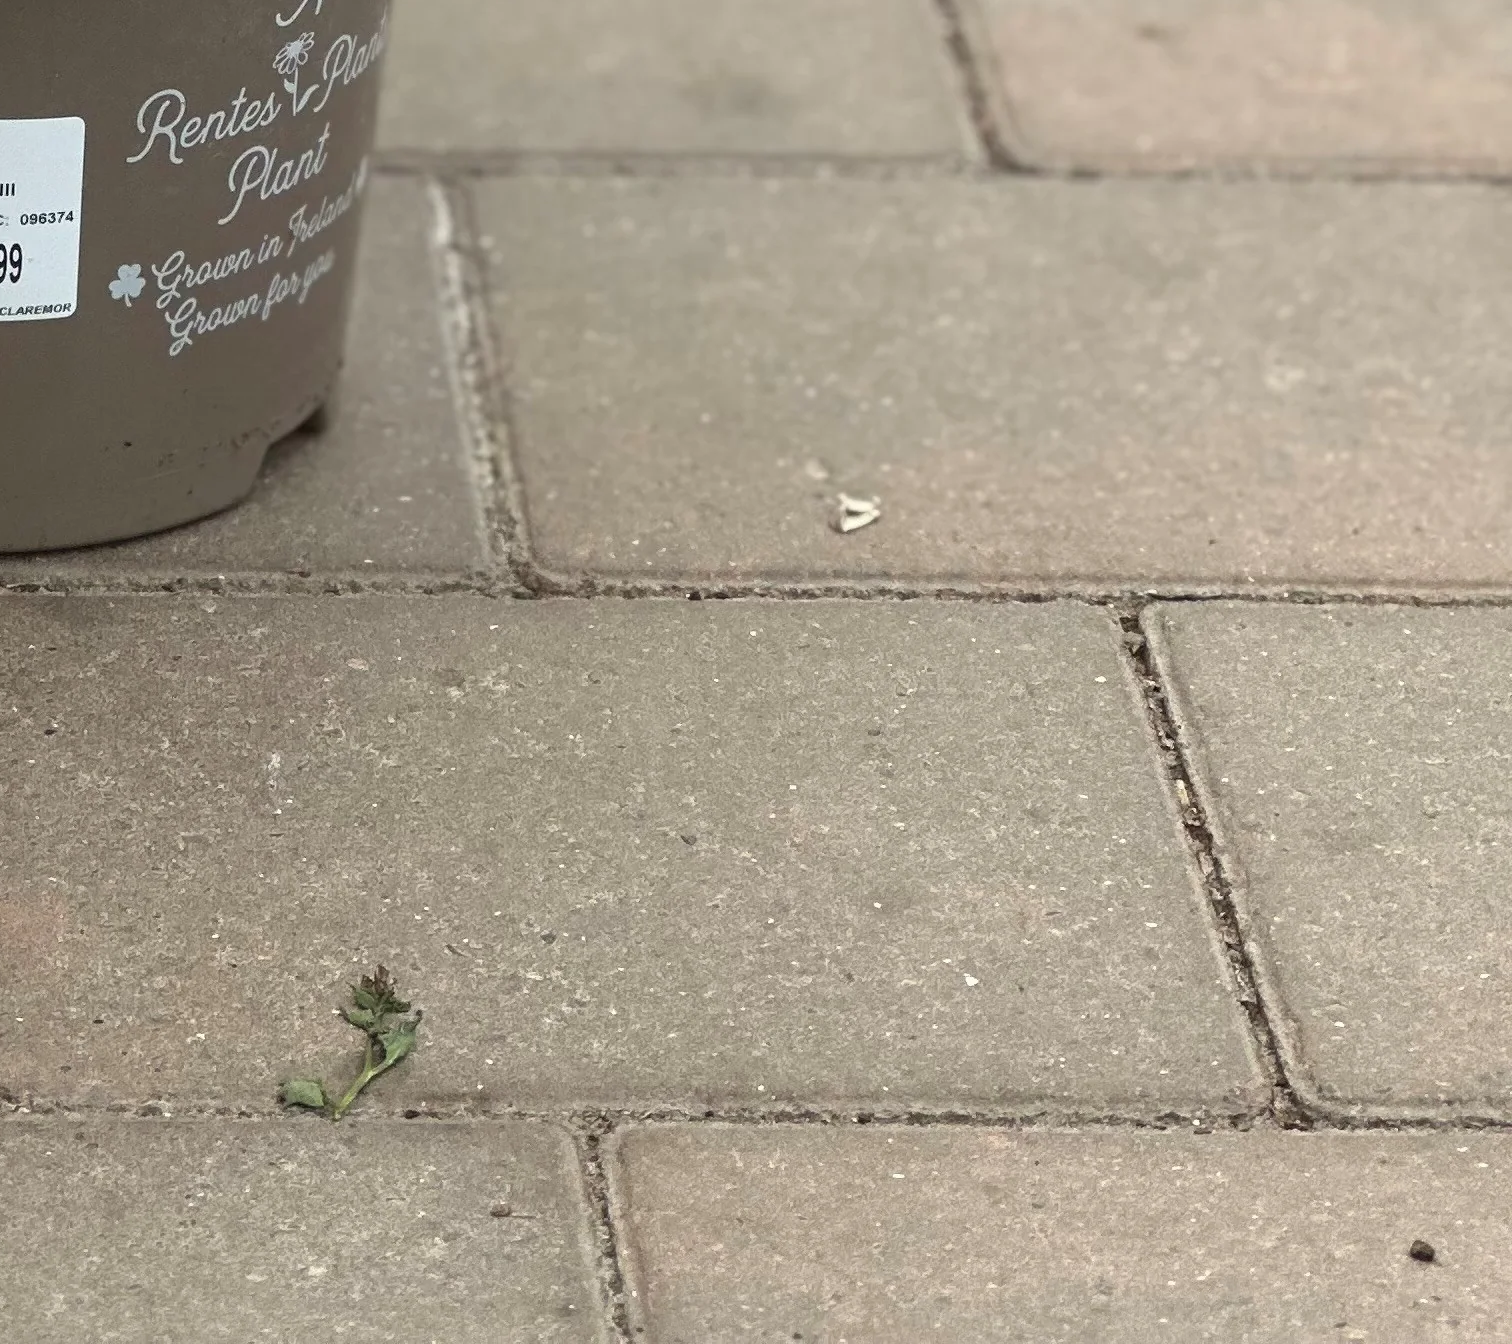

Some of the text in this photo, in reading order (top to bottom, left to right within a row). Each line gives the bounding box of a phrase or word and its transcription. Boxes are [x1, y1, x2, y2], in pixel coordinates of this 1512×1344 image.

[126, 87, 282, 164] Rentes
[217, 122, 330, 225] Plant
[19, 210, 74, 226] 096374
[151, 250, 255, 308] Grown
[257, 234, 284, 264] in
[165, 293, 262, 357] Grown
[260, 276, 297, 321] for
